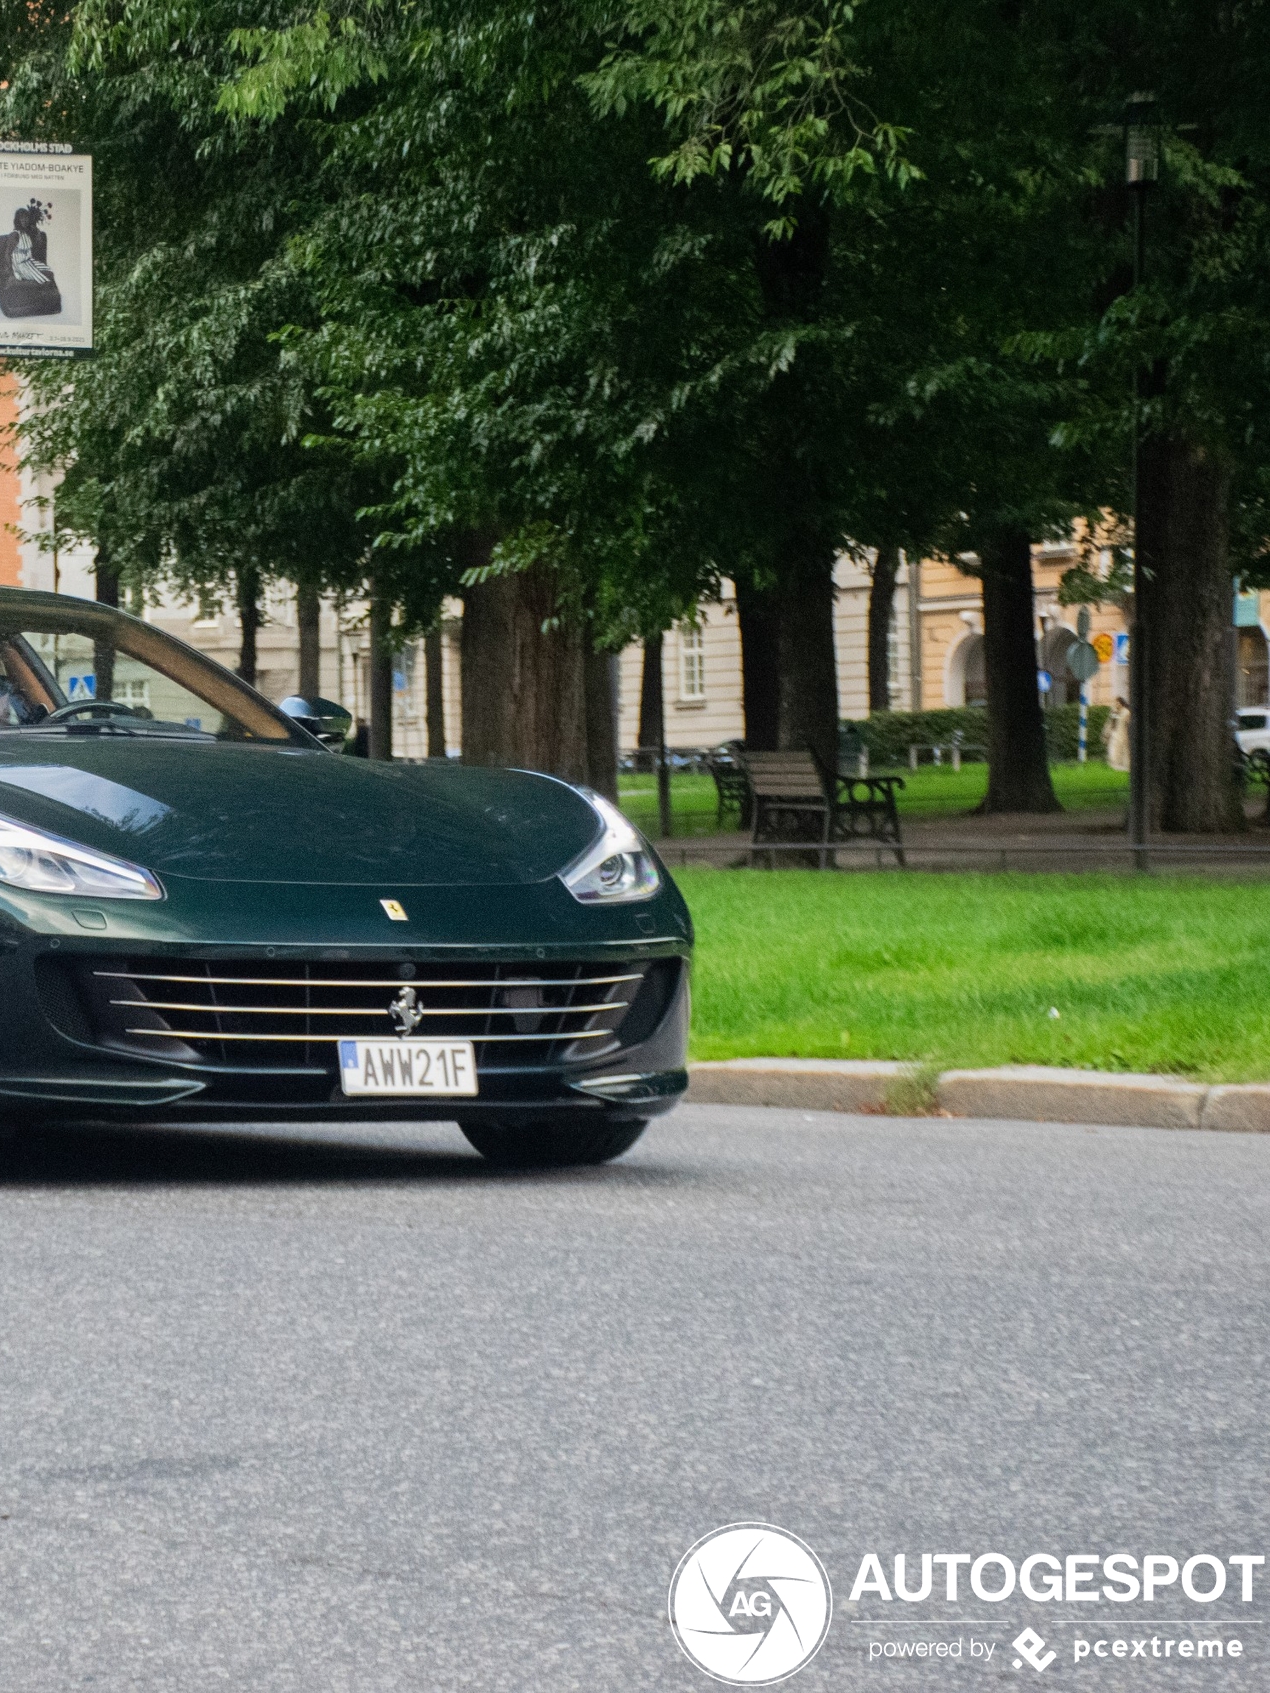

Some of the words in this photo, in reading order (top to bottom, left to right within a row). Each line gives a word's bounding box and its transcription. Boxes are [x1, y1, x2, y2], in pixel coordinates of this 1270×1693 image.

[49, 142, 73, 154] STAD
[10, 161, 84, 174] YIADOM-BOAKYE
[364, 1048, 466, 1087] AWW21F
